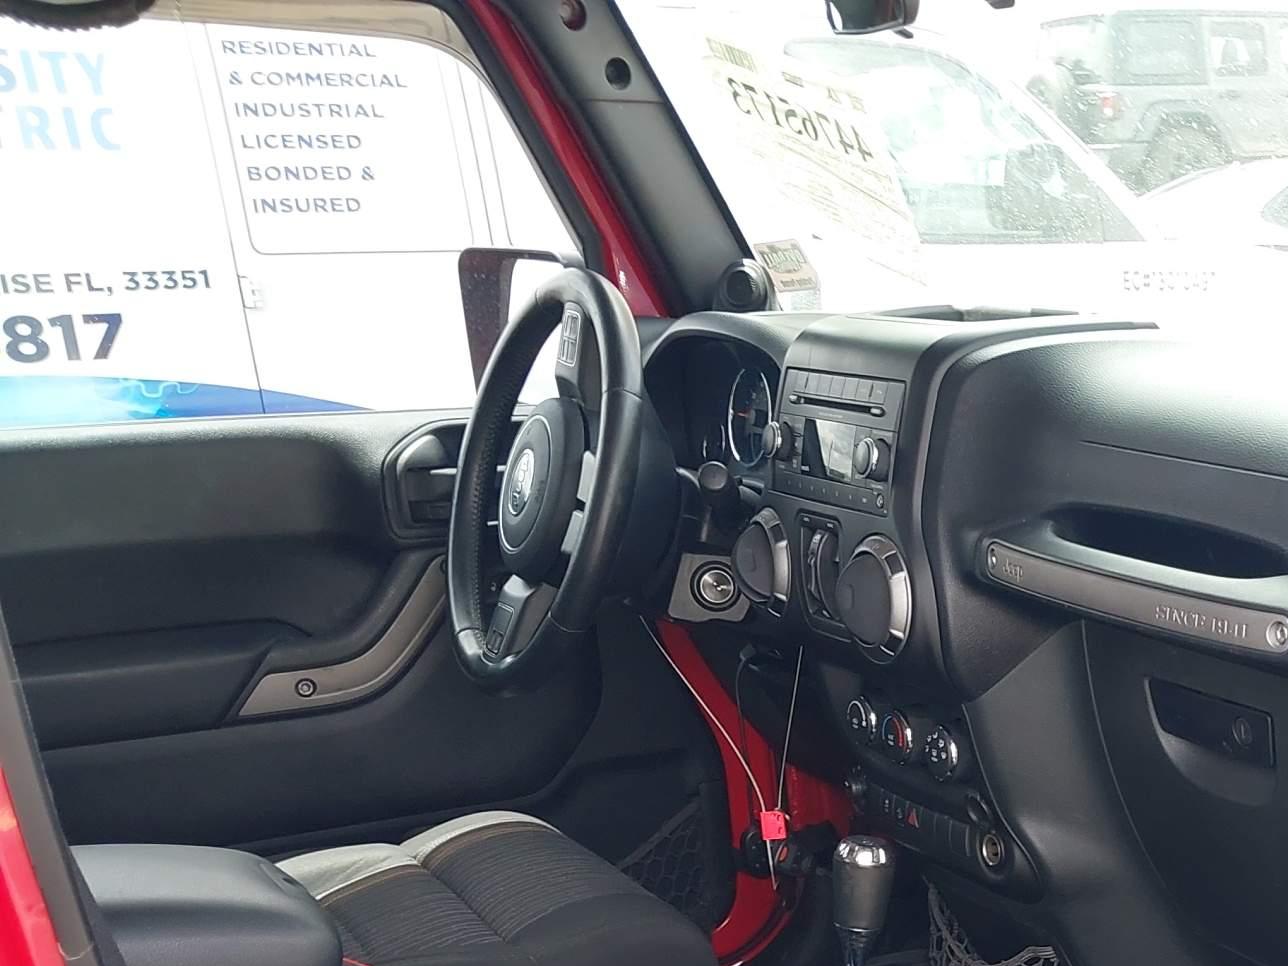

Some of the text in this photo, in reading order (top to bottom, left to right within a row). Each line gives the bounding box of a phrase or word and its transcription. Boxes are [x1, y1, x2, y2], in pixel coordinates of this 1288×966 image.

[221, 39, 377, 58] RESIDENTIAL
[228, 70, 408, 88] & COMMERCIAL
[234, 102, 385, 119] INDUSTRIAL
[0, 104, 121, 151] RIC
[240, 134, 362, 150] LICENSED
[246, 165, 375, 182] BONDED &
[252, 197, 361, 214] INSURED
[0, 269, 212, 297] ISE FL, 33351
[2, 312, 123, 364] 817
[1154, 604, 1206, 630] SINCE
